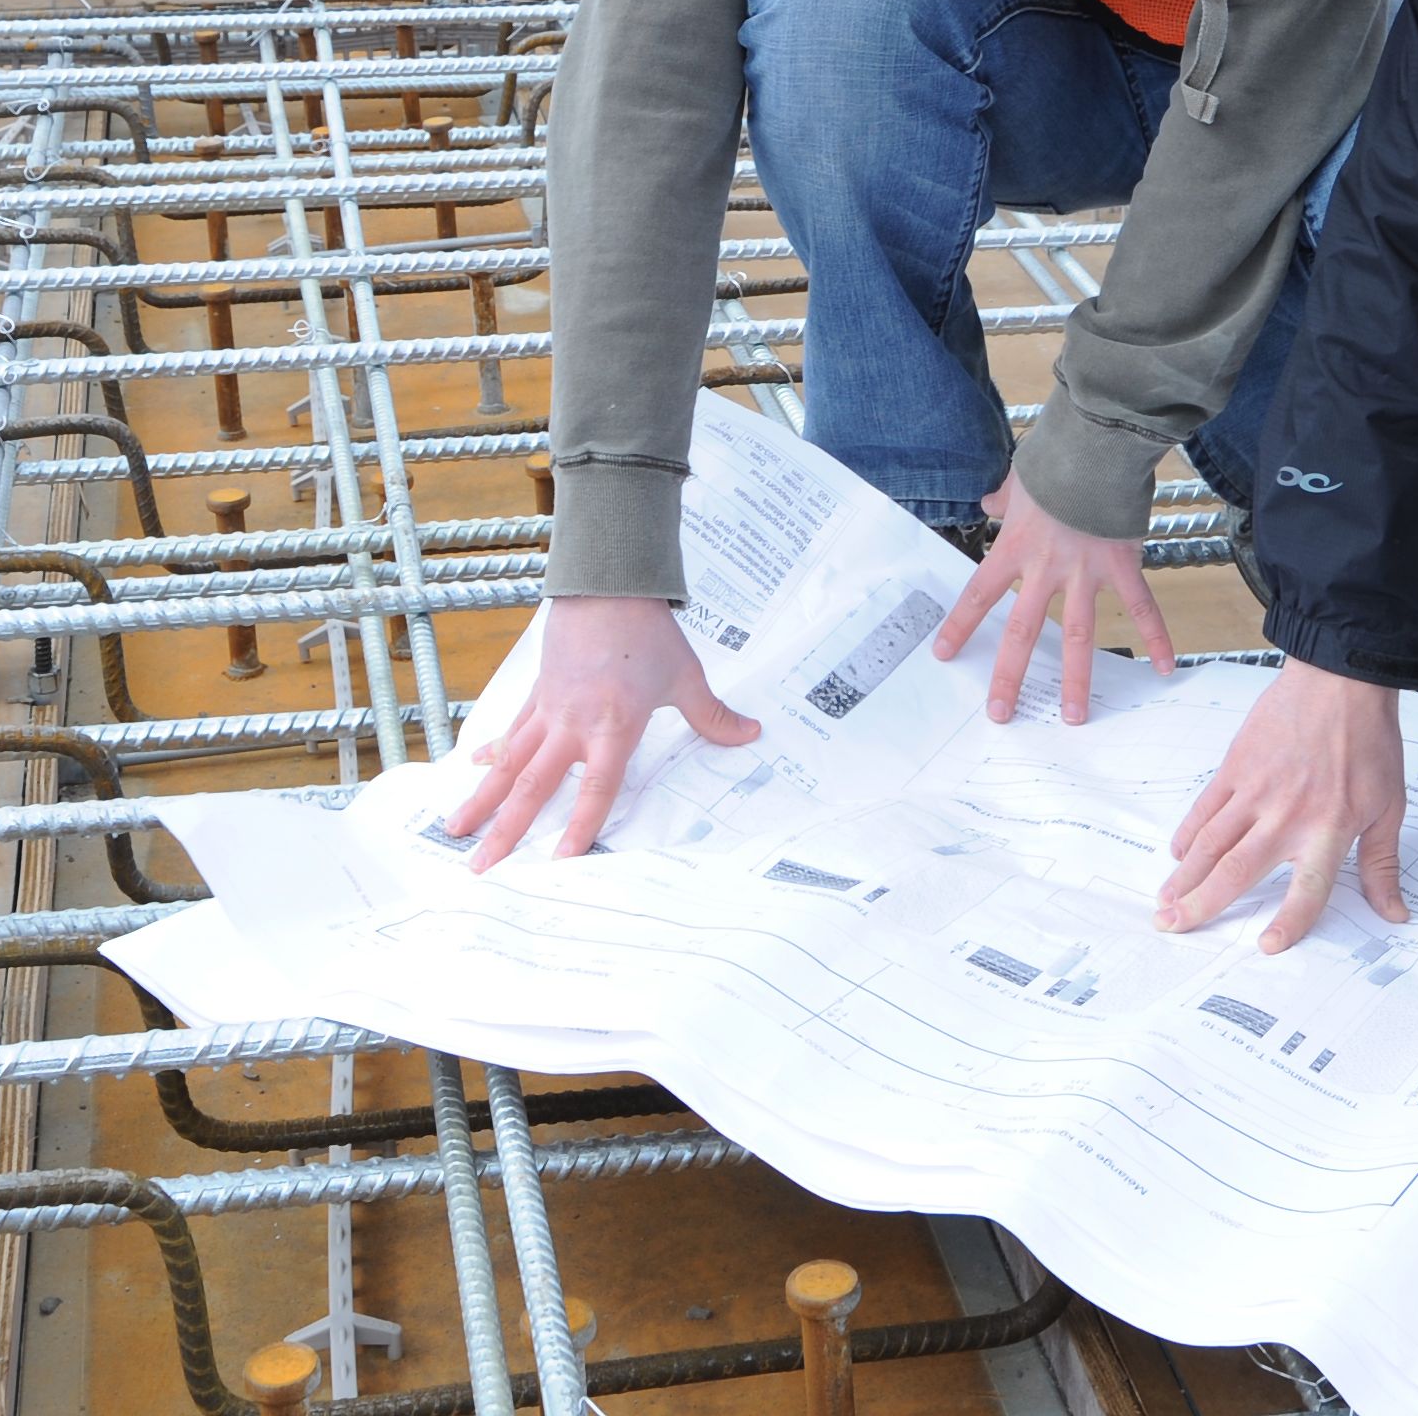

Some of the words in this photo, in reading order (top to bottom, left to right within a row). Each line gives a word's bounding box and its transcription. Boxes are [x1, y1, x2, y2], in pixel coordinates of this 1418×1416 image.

[750, 451, 767, 467] Date
[749, 469, 765, 483] final
[791, 470, 805, 481] mm
[765, 480, 794, 507] Rapport
[734, 487, 784, 531] expérimentale
[763, 498, 787, 520] détails
[786, 518, 796, 527] et
[798, 507, 823, 531] Dessin
[785, 530, 807, 552] Route
[796, 526, 813, 544] Plan
[776, 552, 794, 570] RDC
[773, 566, 786, 578] des
[771, 577, 780, 587] de
[799, 715, 831, 741] Carotte
[1231, 1036, 1244, 1045] et
[1245, 1045, 1265, 1060] T-9
[1267, 1056, 1359, 1111] Thermistances
[1077, 1140, 1094, 1154] 85
[1096, 1154, 1148, 1195] Mélange
